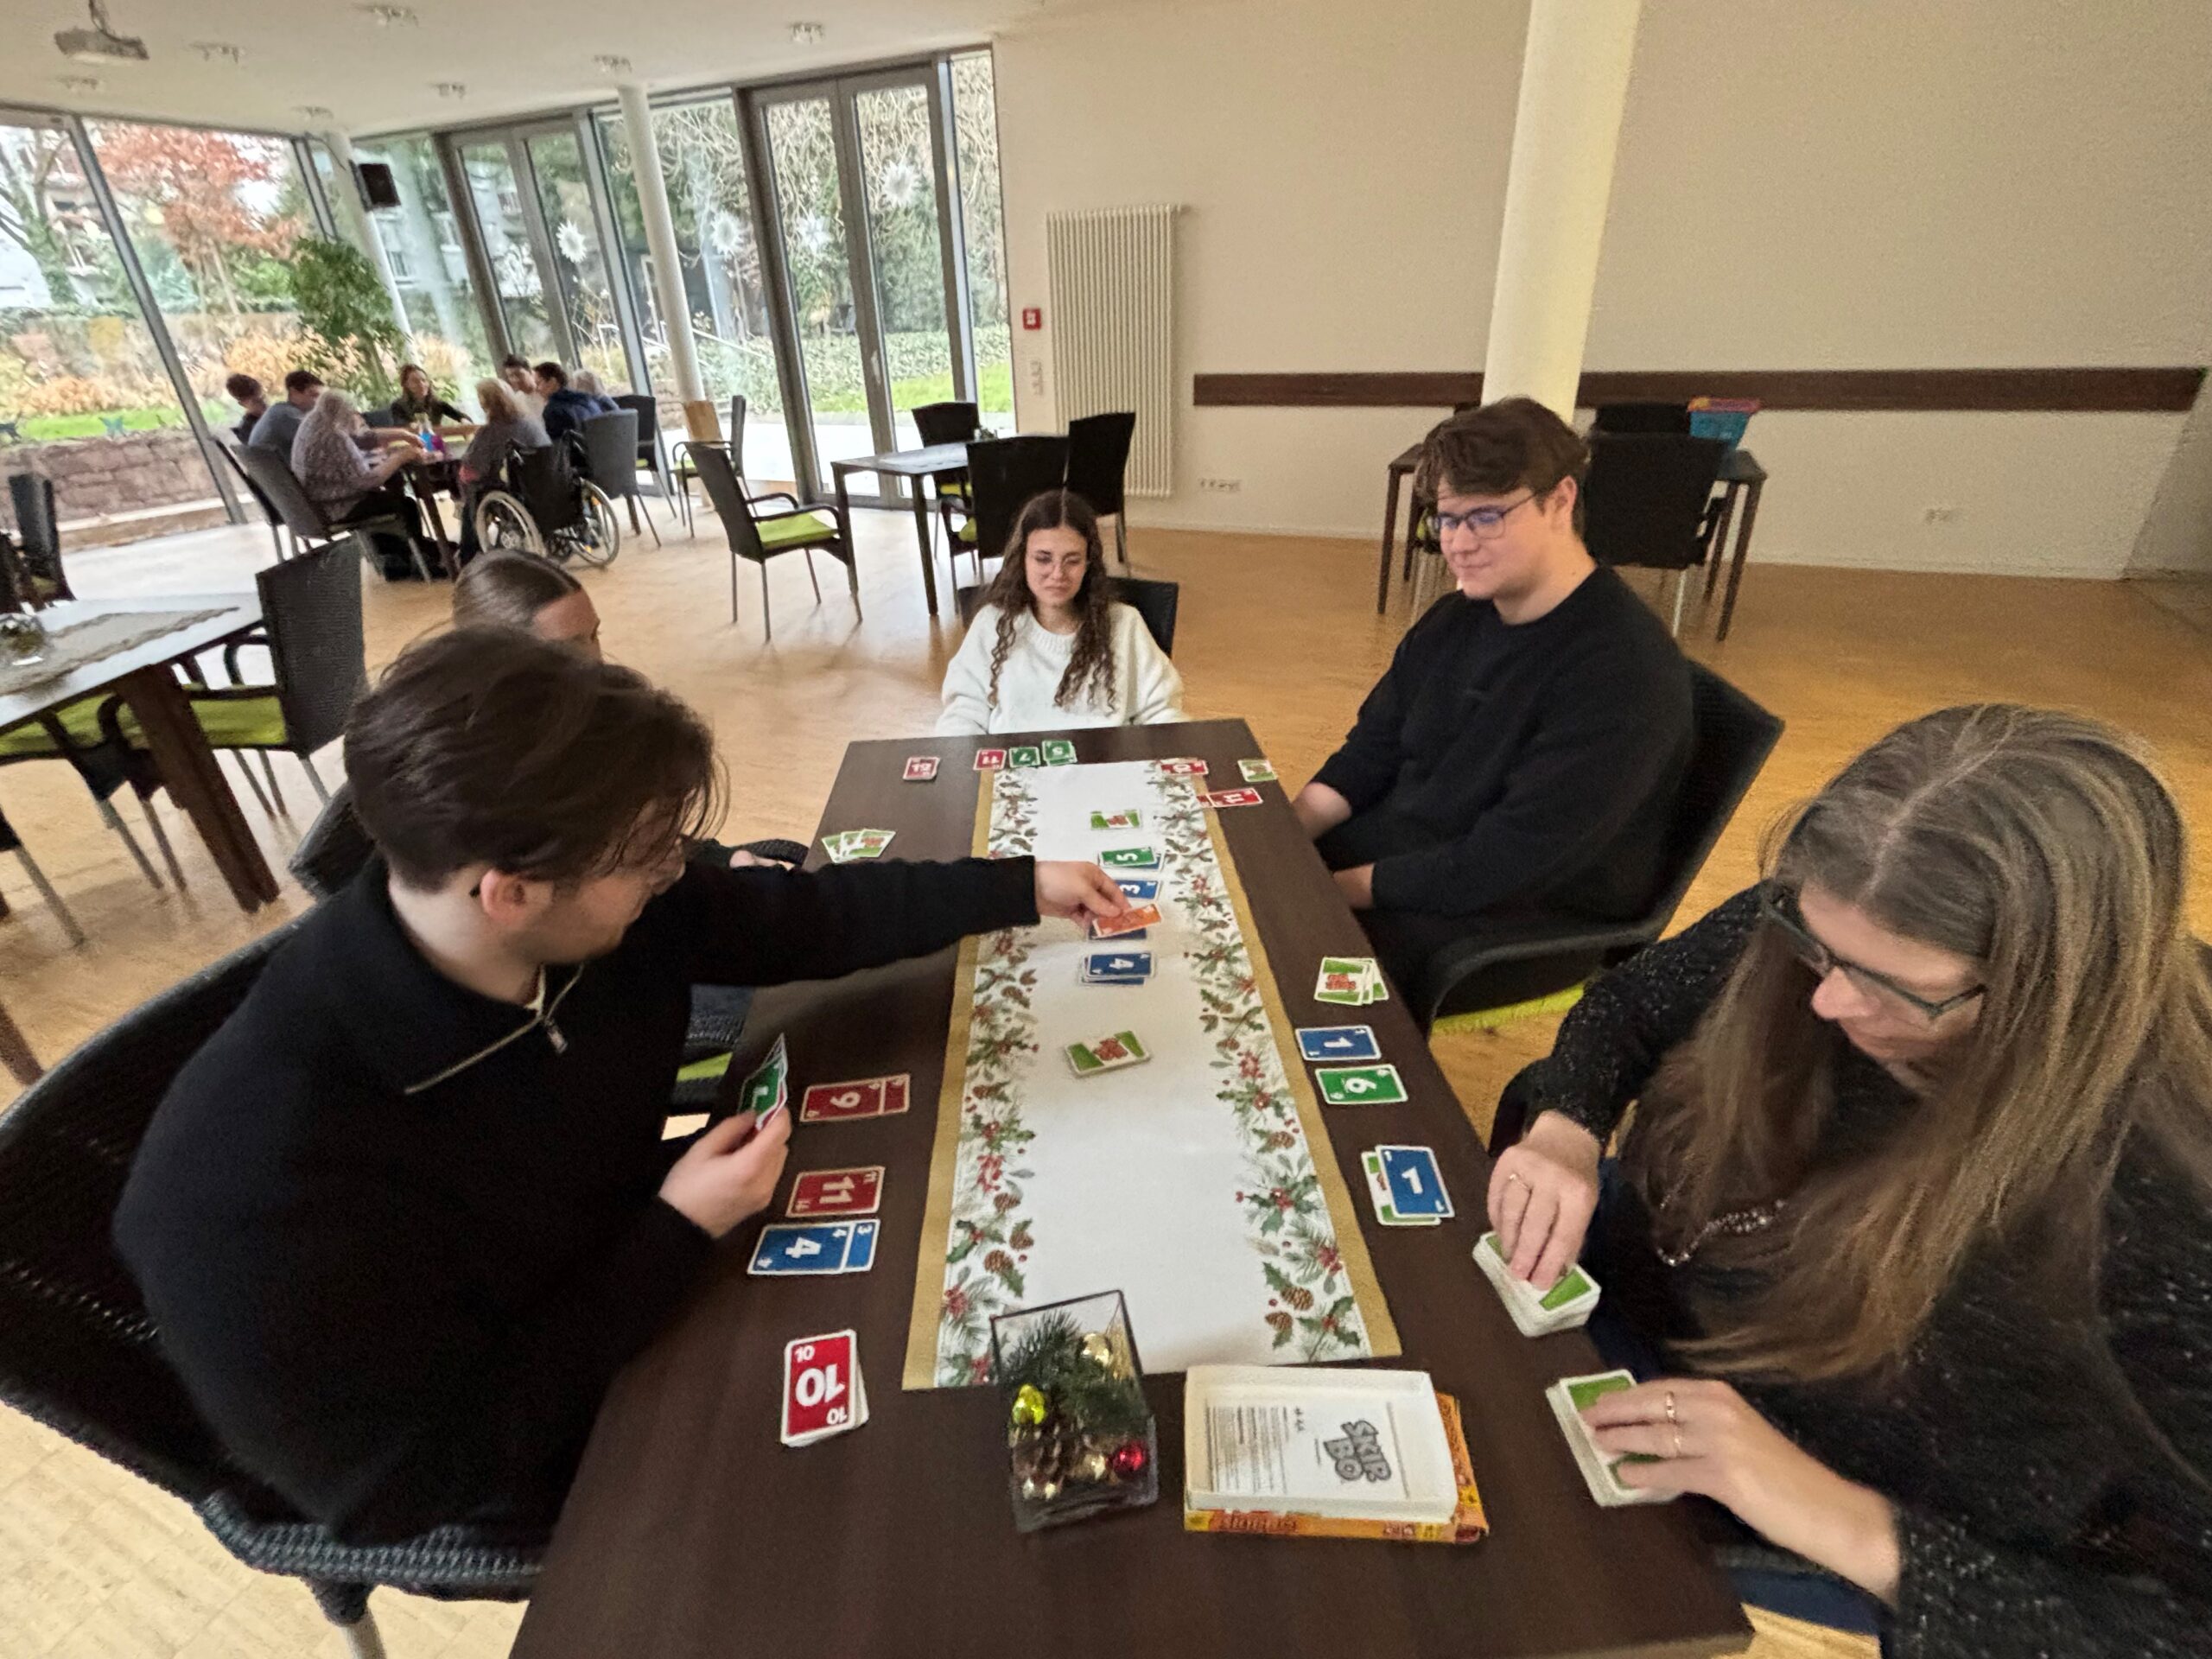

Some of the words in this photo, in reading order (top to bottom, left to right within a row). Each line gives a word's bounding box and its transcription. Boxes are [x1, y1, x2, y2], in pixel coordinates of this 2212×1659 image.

[1116, 853, 1139, 861] 5
[1119, 884, 1141, 895] 3
[1109, 957, 1135, 969] 4
[1324, 1036, 1354, 1048] 1
[819, 1175, 855, 1204] 11
[1402, 1166, 1423, 1194] 1
[857, 1224, 873, 1236] 3
[785, 1236, 822, 1259] 4
[795, 1344, 816, 1363] 10
[795, 1363, 846, 1407] 10
[826, 1406, 847, 1425] 10
[1323, 1438, 1364, 1482] BO
